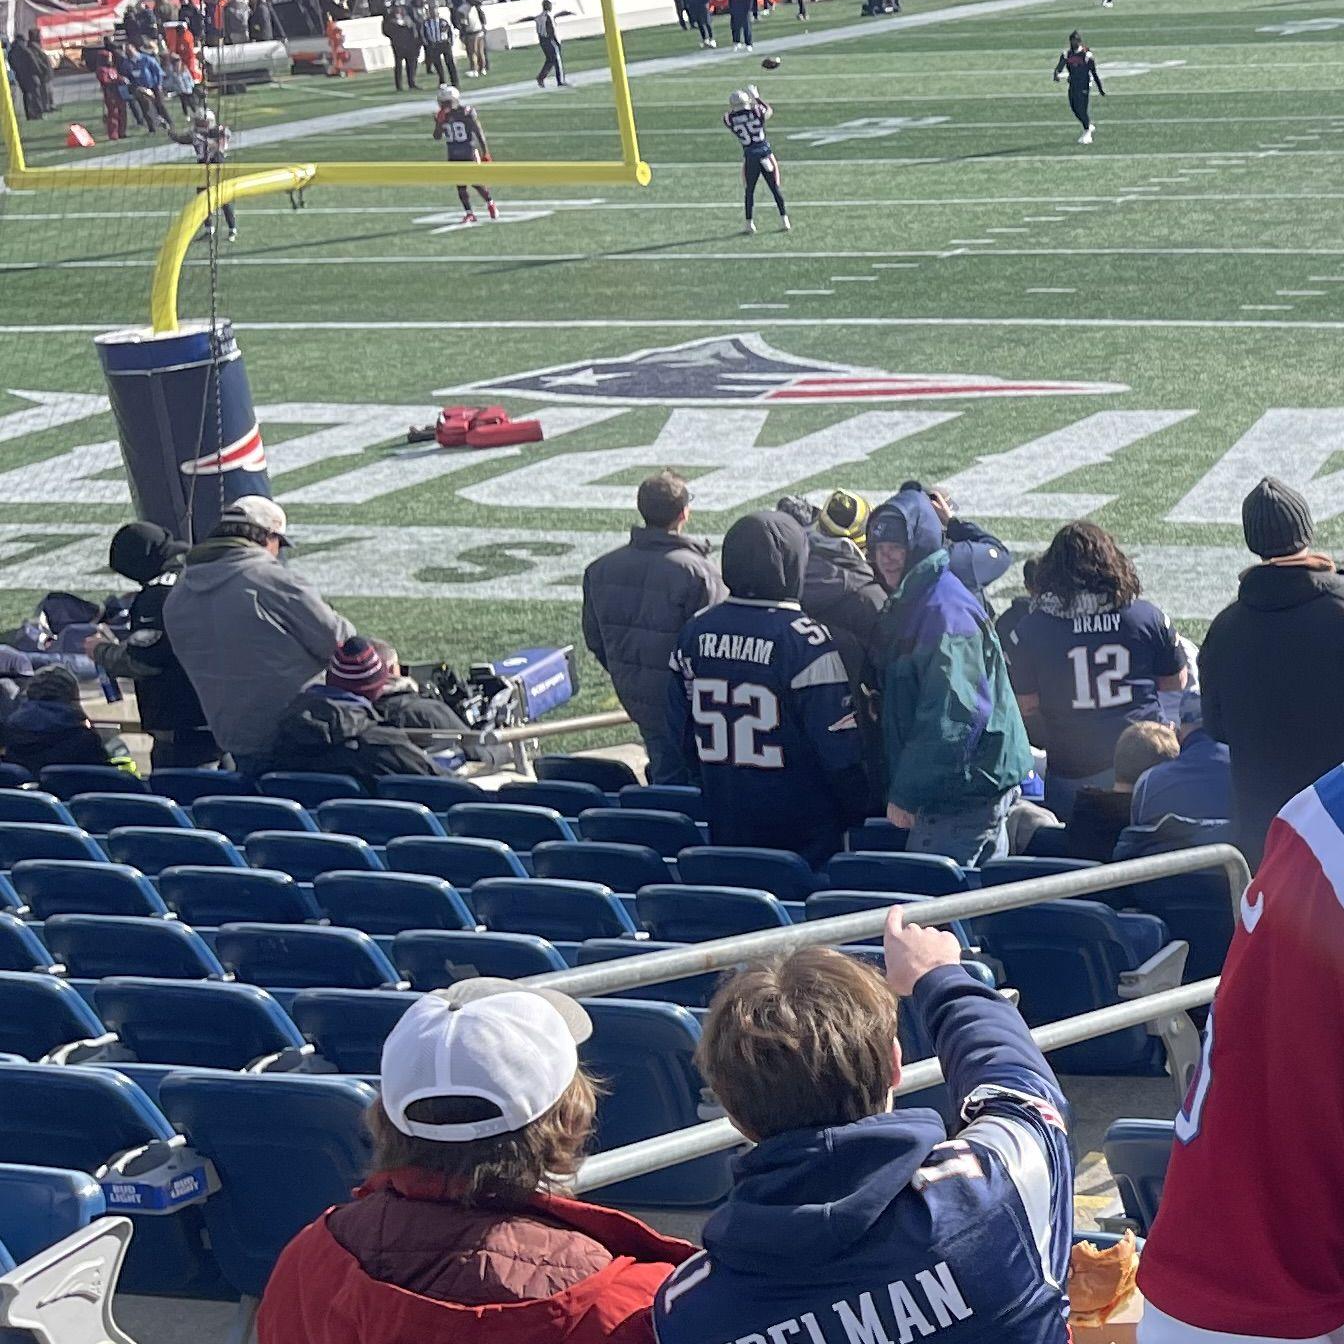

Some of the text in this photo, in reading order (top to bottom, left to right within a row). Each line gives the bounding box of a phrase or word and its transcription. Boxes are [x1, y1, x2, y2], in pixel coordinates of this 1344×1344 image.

[1073, 613, 1122, 633] BRADY
[1067, 643, 1134, 710] 12
[692, 678, 785, 769] 52
[109, 1192, 142, 1204] LIGHT
[111, 1184, 135, 1195] BUD
[170, 1182, 199, 1199] LIGHT
